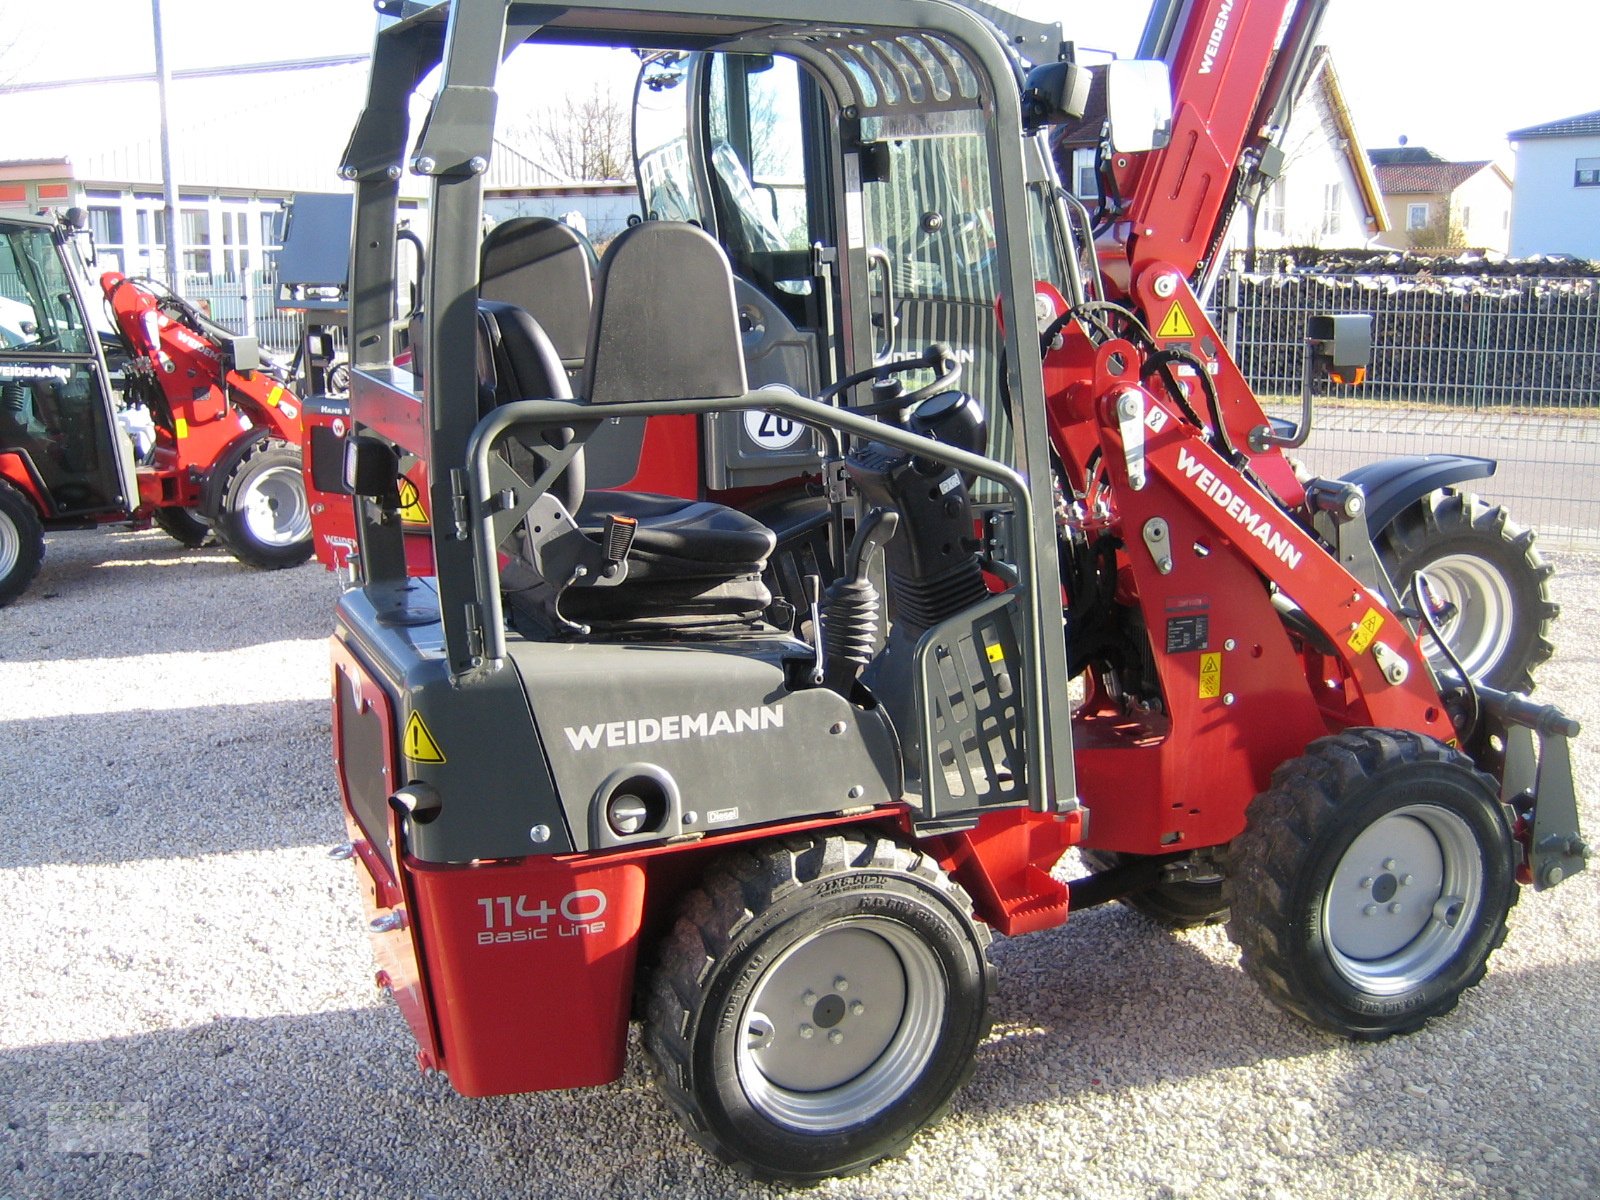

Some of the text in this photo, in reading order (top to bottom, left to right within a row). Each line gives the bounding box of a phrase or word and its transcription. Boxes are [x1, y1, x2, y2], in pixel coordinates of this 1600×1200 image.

[177, 330, 222, 361] WEIDEM
[1176, 447, 1302, 571] WEIDEMANN
[563, 704, 784, 751] WEIDEMANN
[708, 807, 737, 822] Diesel
[477, 888, 607, 929] 1140
[477, 920, 606, 945] Basic Line
